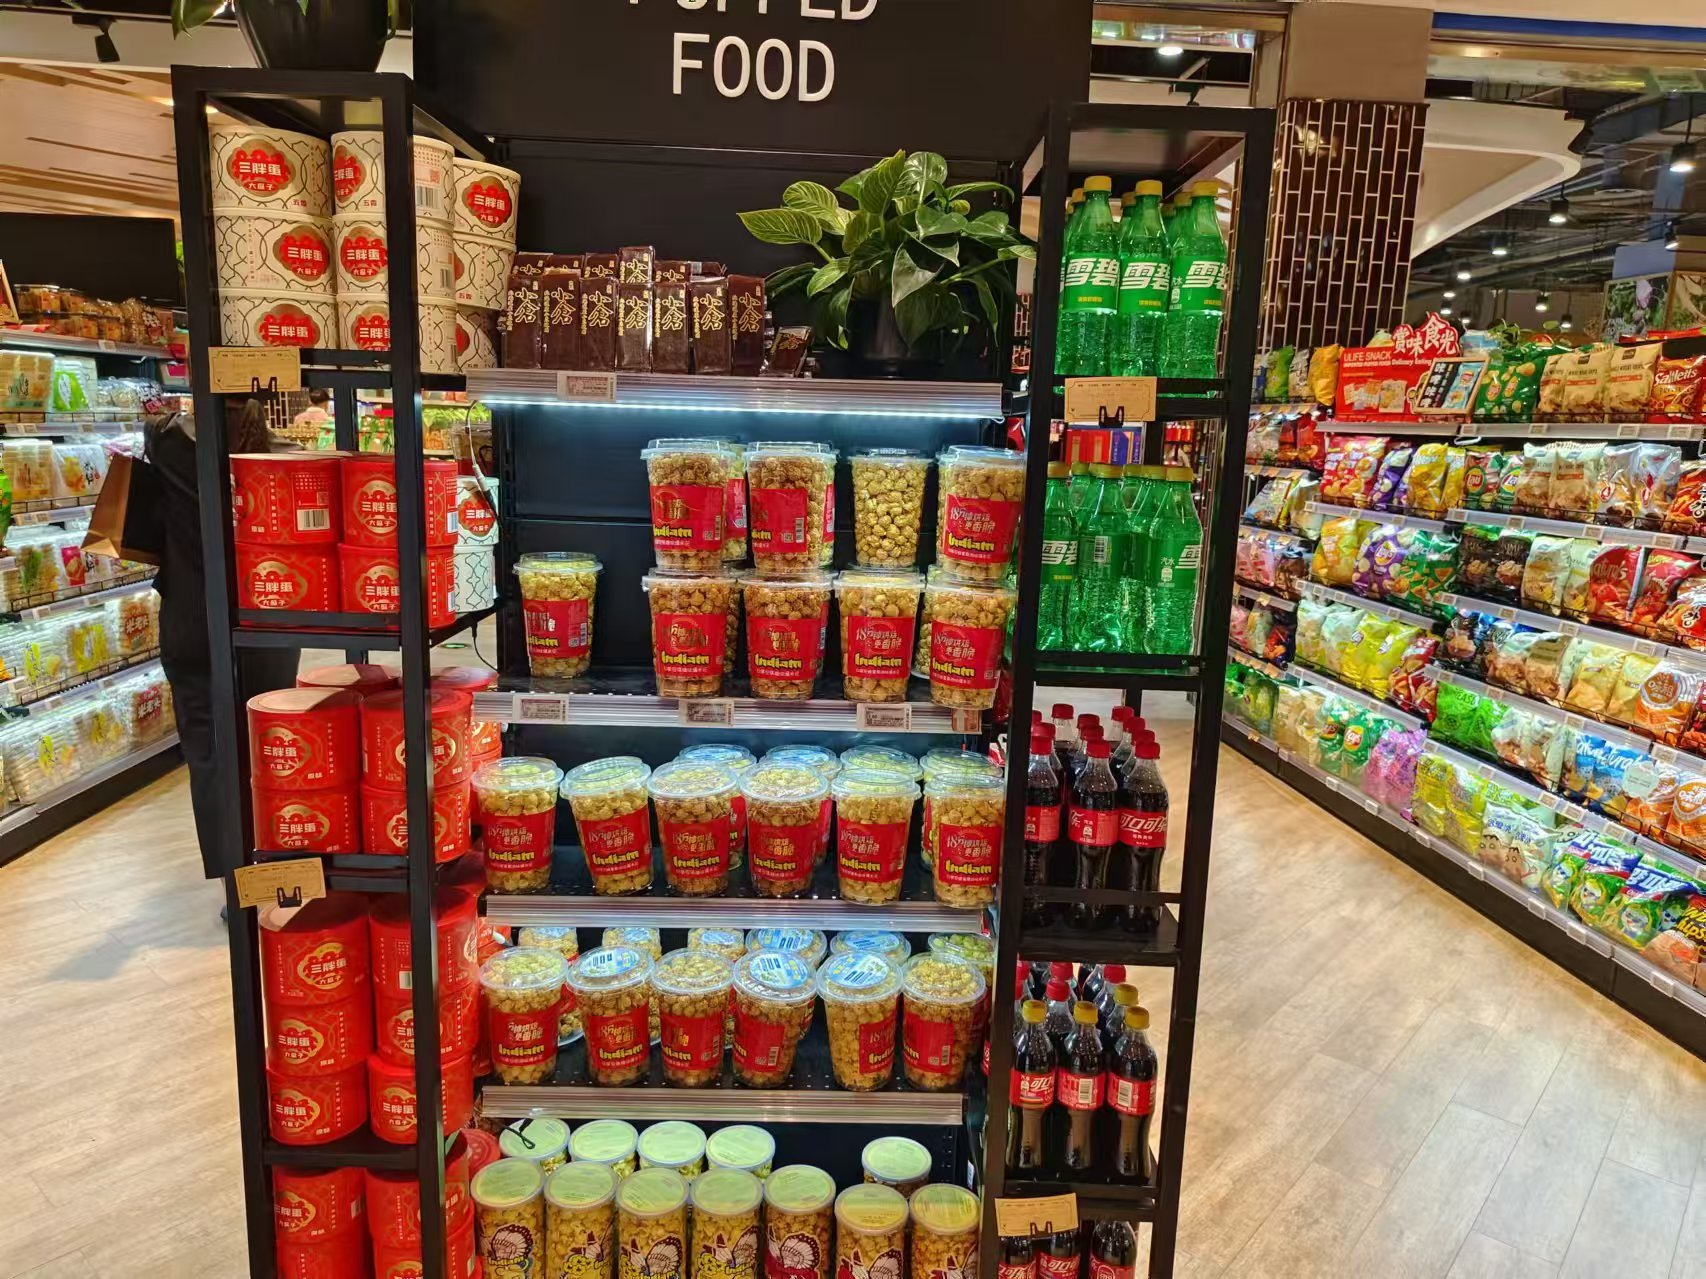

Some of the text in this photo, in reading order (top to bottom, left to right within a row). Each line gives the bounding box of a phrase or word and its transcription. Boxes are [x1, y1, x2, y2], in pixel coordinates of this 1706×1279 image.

[673, 32, 835, 102] FOOD
[239, 161, 282, 176] 三胖蛋
[287, 246, 323, 262] 三胖蛋
[346, 249, 380, 261] 三胖蛋
[1065, 257, 1120, 287] 雪碧
[268, 325, 309, 338] 三胖蛋
[1366, 350, 1391, 360] SNACK
[254, 581, 293, 593] 三胖蛋
[264, 746, 297, 757] 三胖蛋
[280, 822, 316, 834] 三胖蛋
